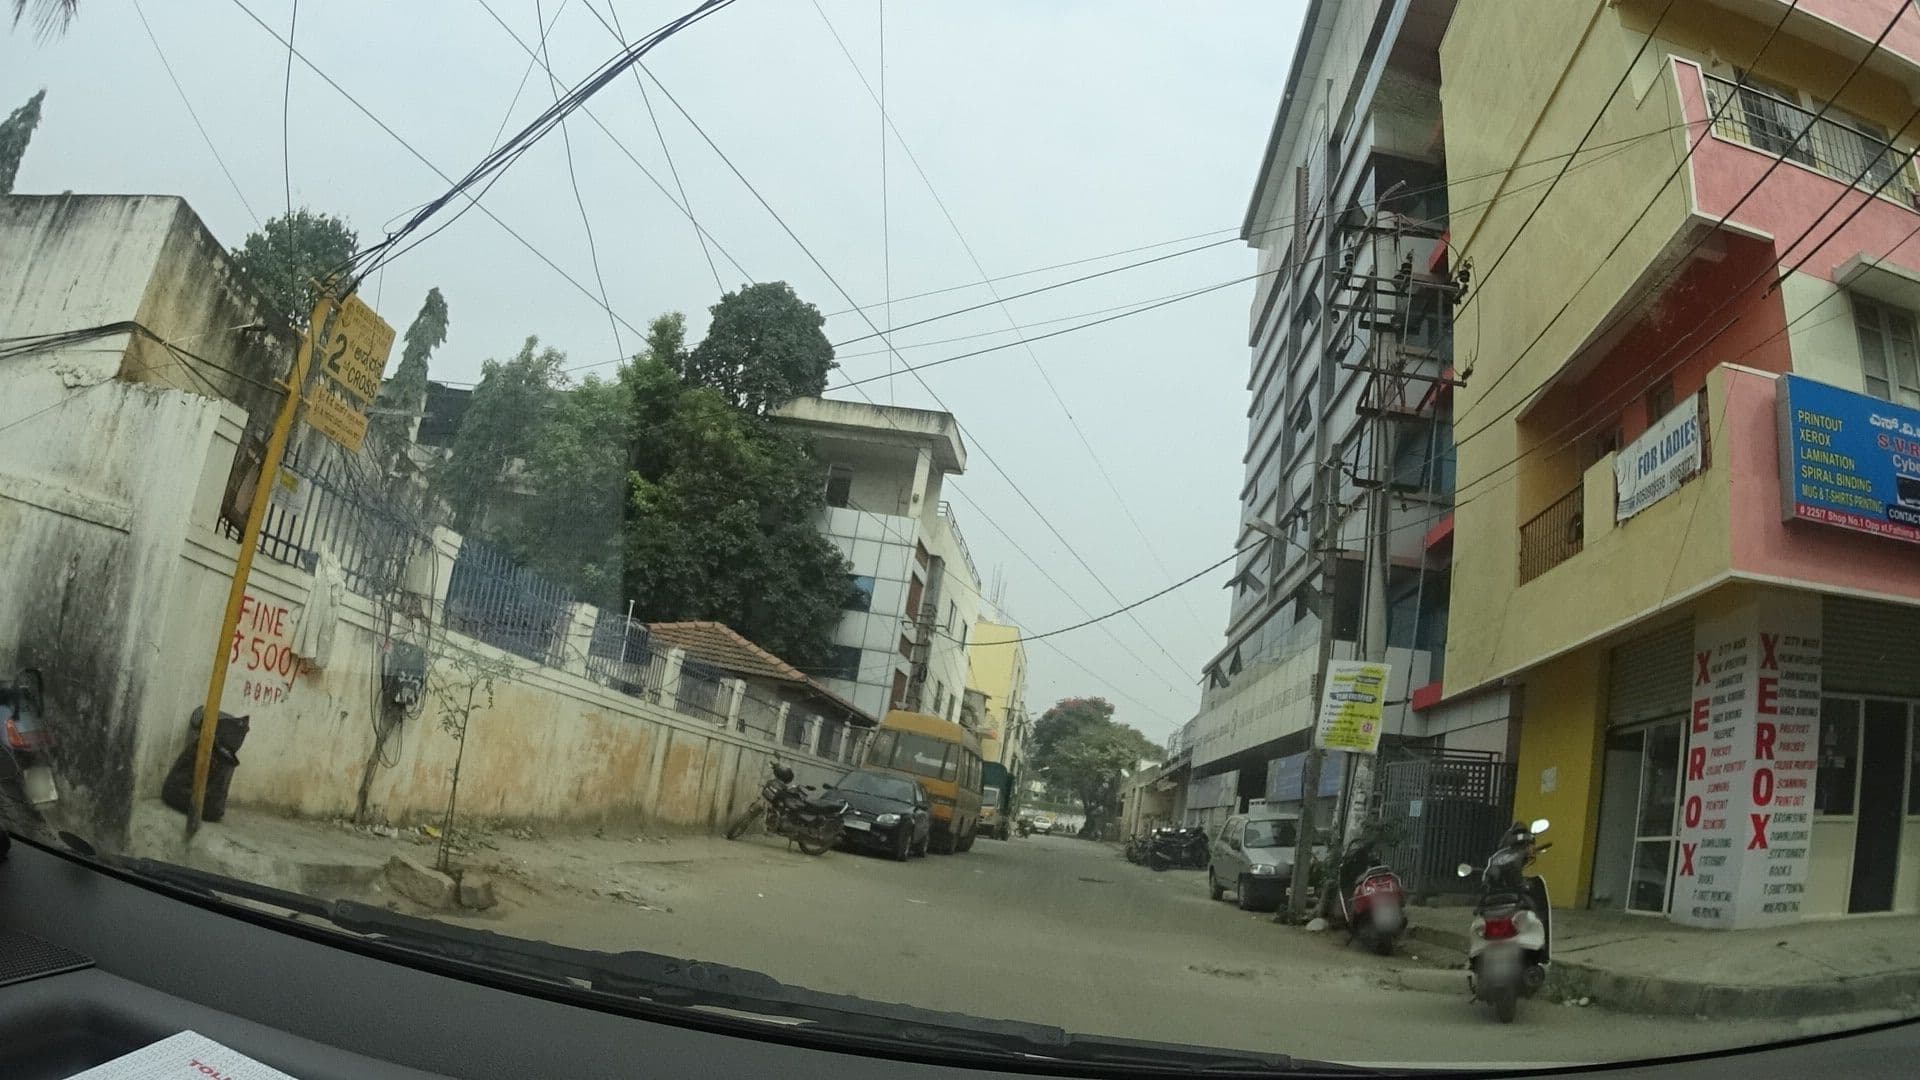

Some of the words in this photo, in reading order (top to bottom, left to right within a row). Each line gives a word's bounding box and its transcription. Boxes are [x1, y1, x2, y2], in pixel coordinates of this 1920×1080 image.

[347, 368, 377, 399] CROSS
[1798, 409, 1844, 433] PRINTOUT
[1638, 445, 1658, 480] FOR
[1660, 415, 1697, 465] LADIES
[1799, 428, 1832, 447] XEROX
[1800, 446, 1856, 472] LAMINATION
[1801, 464, 1835, 485] SPIRAL
[1836, 472, 1873, 493] BINDING
[1802, 483, 1819, 500] MUG
[1854, 494, 1884, 515] PRINTING
[1806, 508, 1827, 517] 225/7
[1828, 511, 1847, 524] Shop
[1865, 520, 1880, 535] Opp
[237, 595, 289, 638] FINE
[1747, 631, 1779, 850] XEROX
[1680, 650, 1712, 876] XEROX
[1777, 778, 1809, 790] SCANNING
[1773, 811, 1808, 824] BROWSING
[1768, 865, 1793, 877] BOOKS
